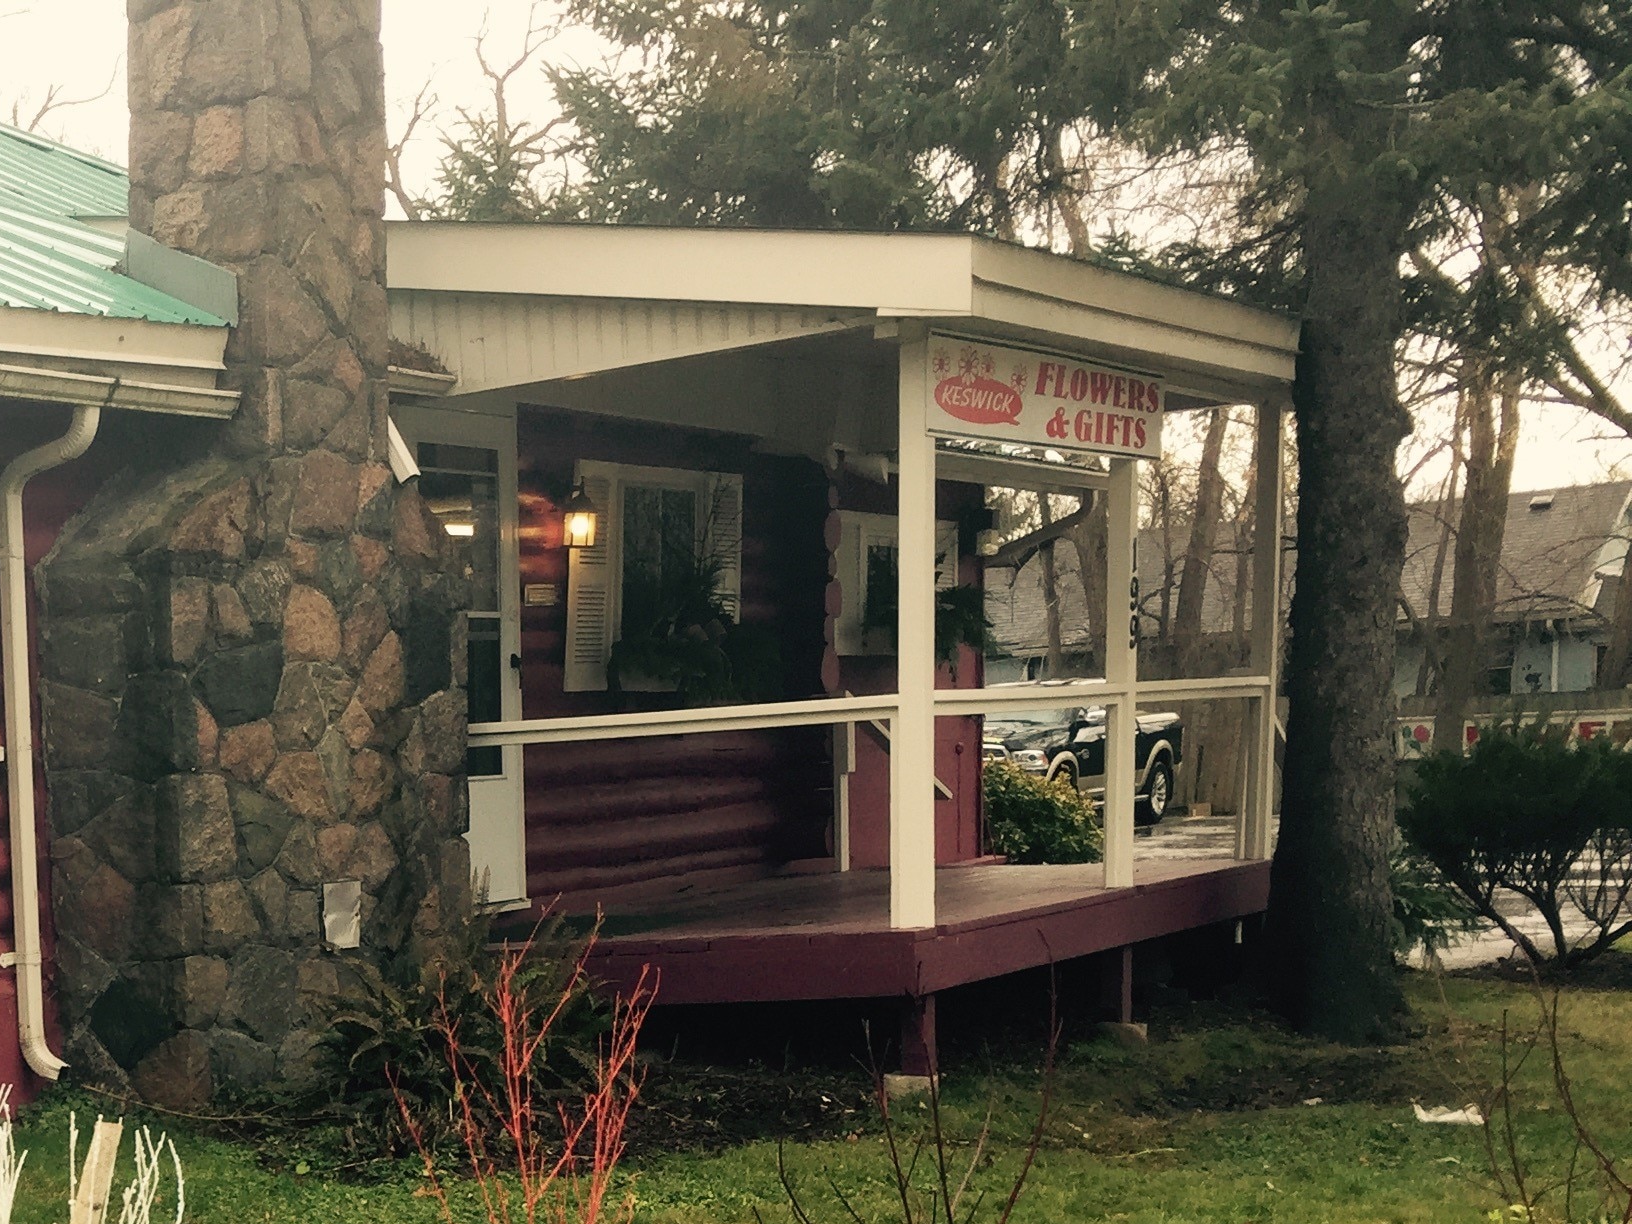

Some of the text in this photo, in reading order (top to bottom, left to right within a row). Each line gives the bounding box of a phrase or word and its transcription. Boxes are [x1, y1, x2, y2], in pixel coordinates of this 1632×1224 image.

[941, 384, 1016, 414] KESWICK
[1034, 361, 1161, 414] FLOWERS
[1045, 406, 1147, 450] & GIFTS
